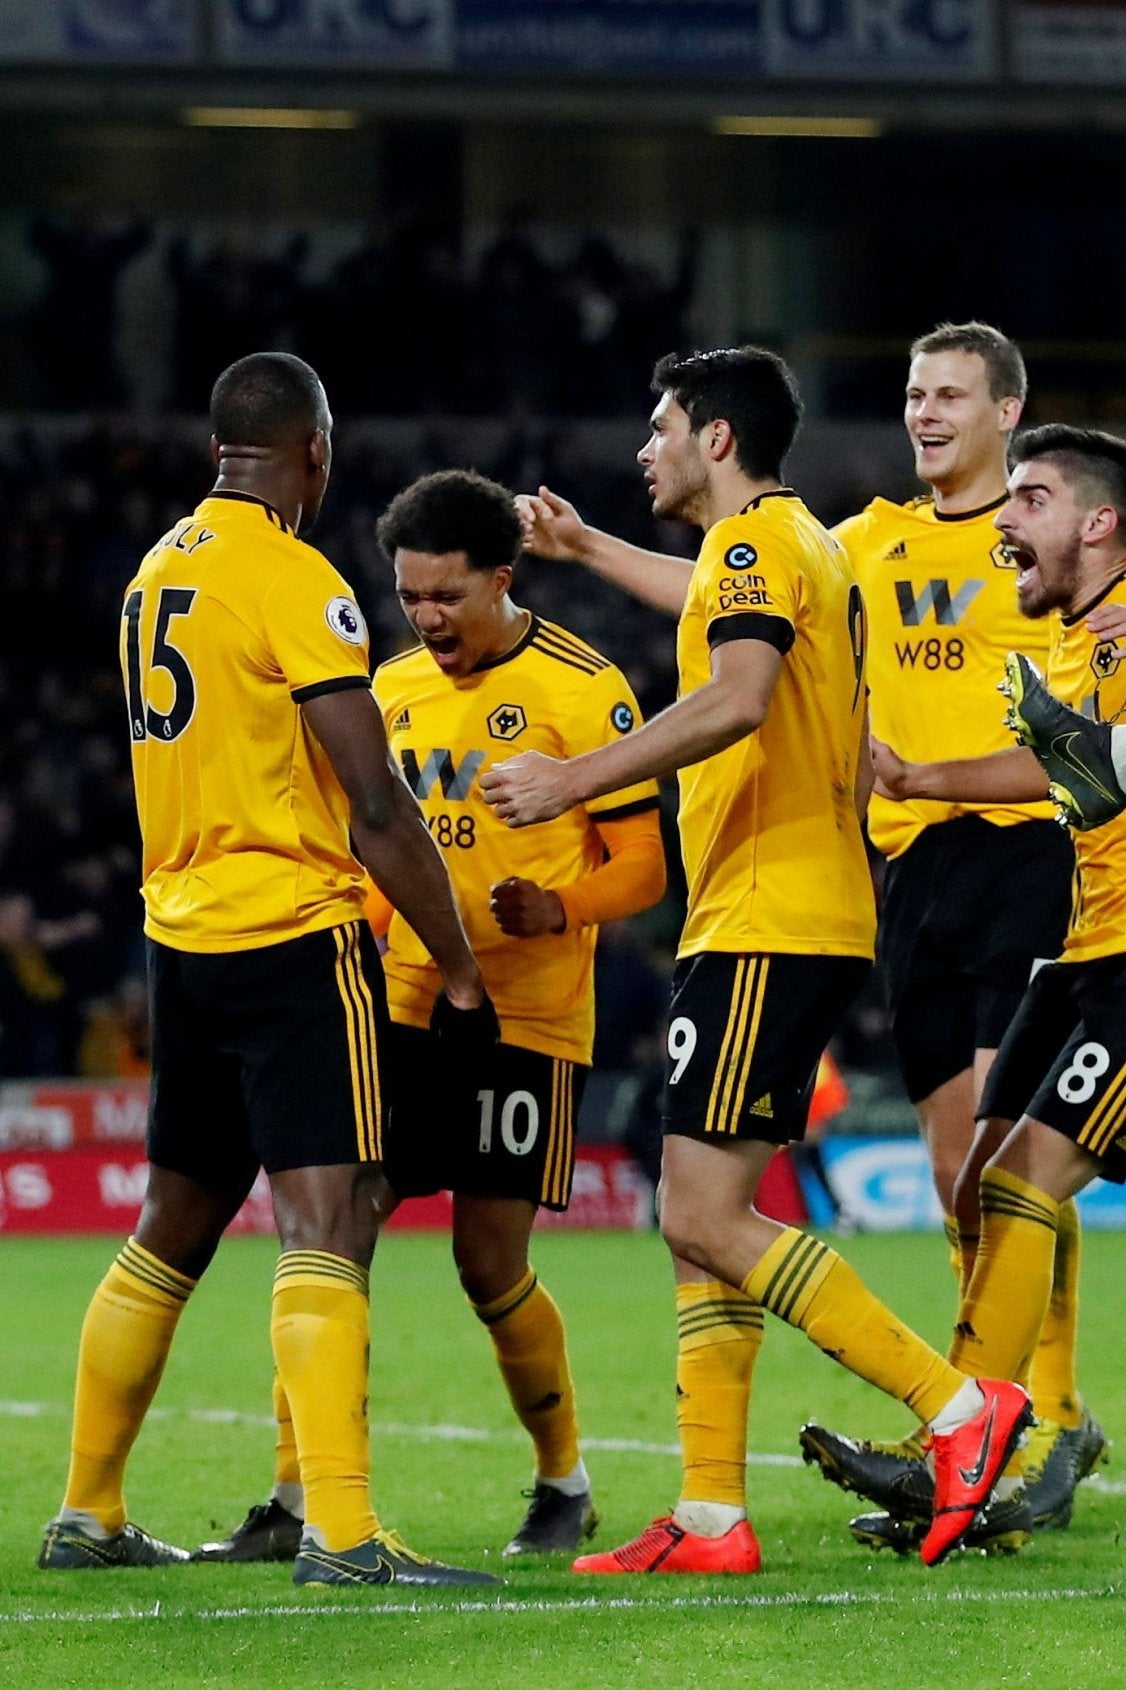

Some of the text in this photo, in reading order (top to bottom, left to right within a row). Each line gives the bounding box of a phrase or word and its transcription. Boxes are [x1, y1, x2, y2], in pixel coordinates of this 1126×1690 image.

[121, 586, 198, 743] 15
[894, 638, 964, 671] W88
[428, 814, 476, 849] 88
[667, 1016, 698, 1085] 9
[1056, 1041, 1110, 1105] 8
[476, 1089, 540, 1156] 10
